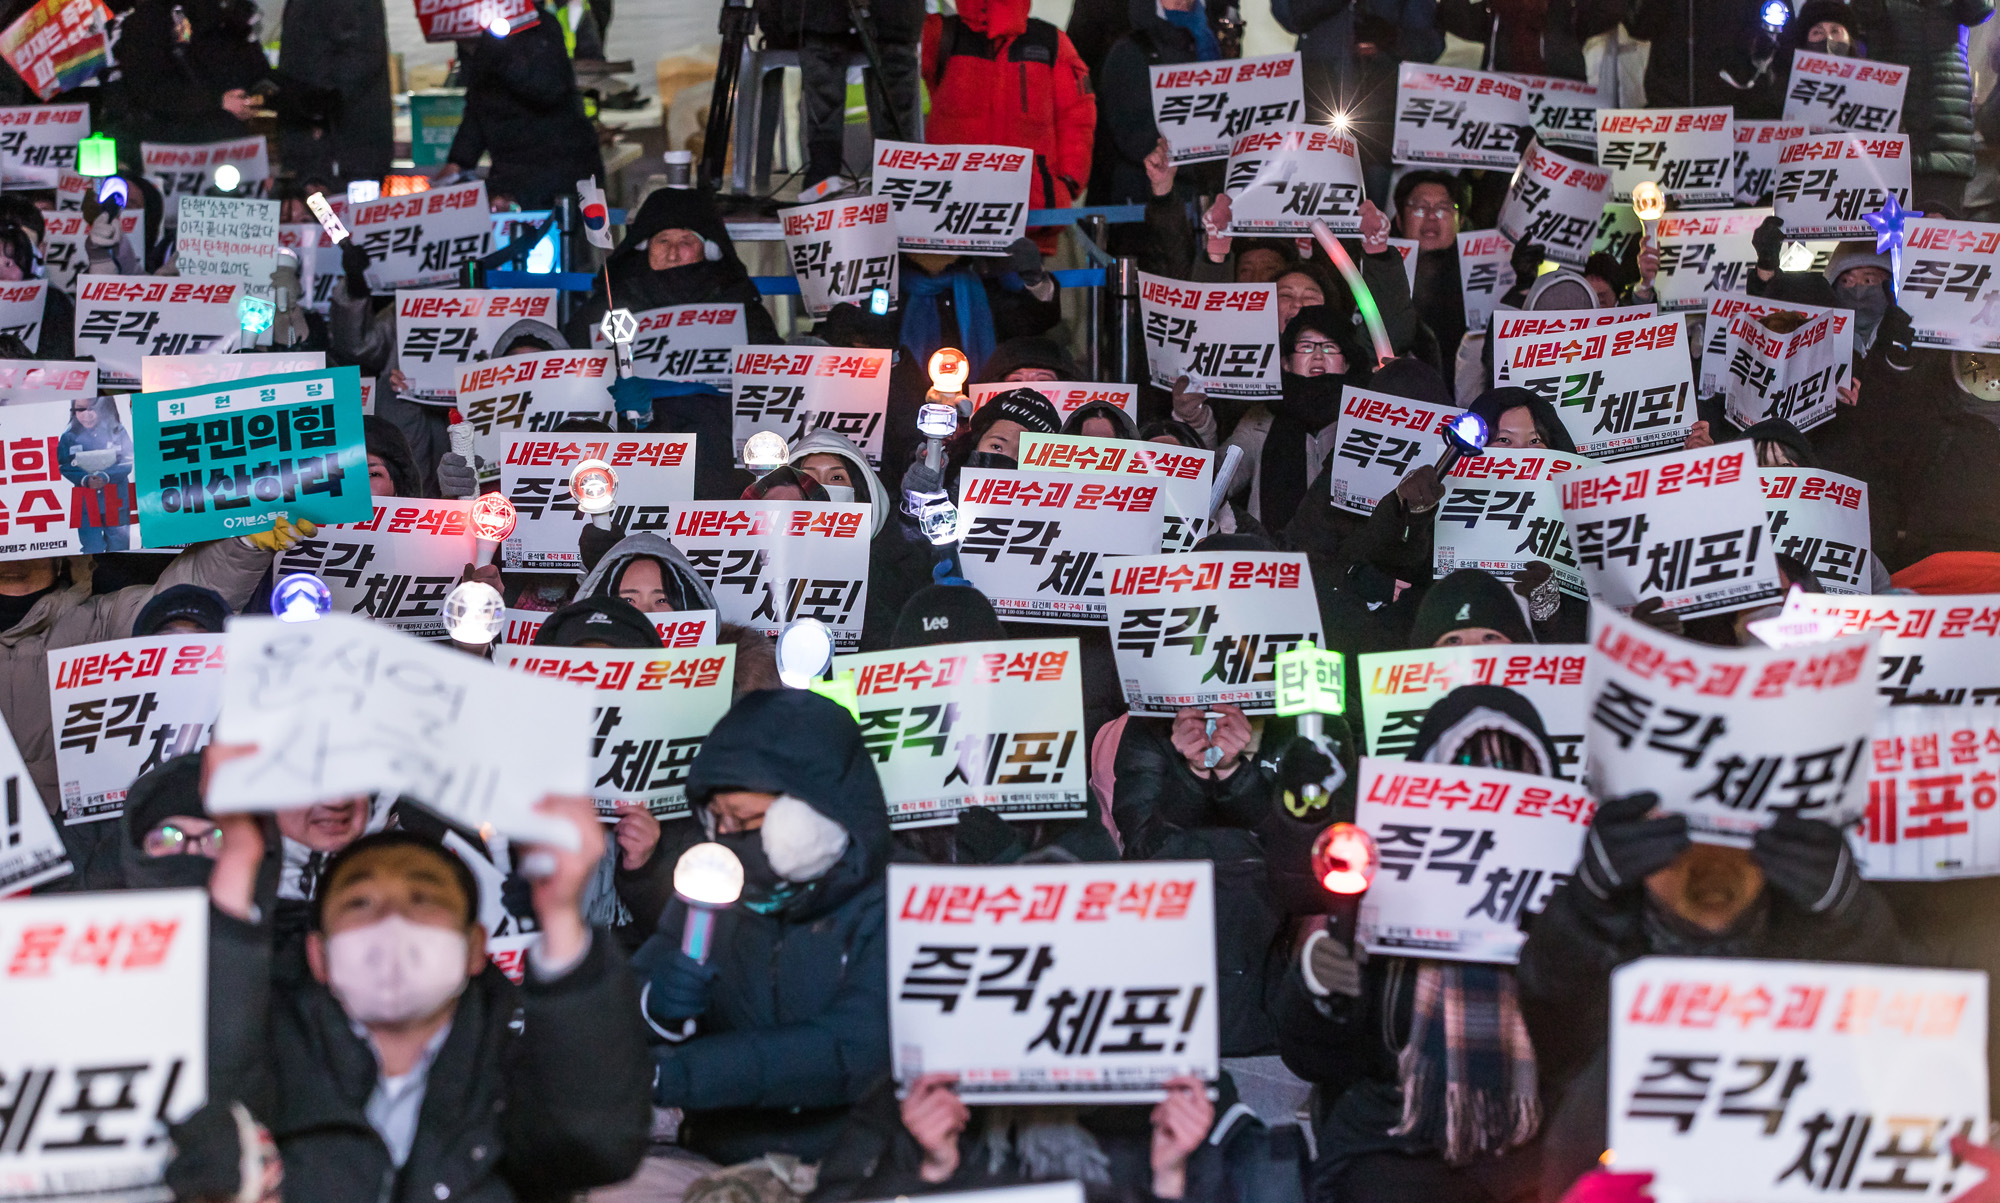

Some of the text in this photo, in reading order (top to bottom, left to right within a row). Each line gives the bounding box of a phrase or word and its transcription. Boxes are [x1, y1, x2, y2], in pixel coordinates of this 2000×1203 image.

[1156, 58, 1295, 90] 내란수괴 윤석열
[1474, 78, 1523, 102] 윤석열
[1795, 56, 1904, 88] 내란수괴 윤석열
[1158, 92, 1229, 126] 즉각
[1789, 78, 1845, 110] 즉각
[35, 109, 82, 124] 윤석열
[1401, 97, 1467, 129] 즉각
[1601, 113, 1727, 134] 내란수괴 윤석열
[1831, 98, 1899, 133] 체포!
[1307, 132, 1355, 159] 윤석열
[1757, 126, 1804, 144] 윤석열
[1779, 139, 1903, 165] 내란수괴 윤석열
[879, 149, 1025, 173] 내란수괴 윤석열
[1601, 141, 1668, 174] 즉각
[1659, 158, 1732, 191] 체포!
[878, 177, 952, 214] 즉각
[1560, 167, 1609, 193] 윤석열
[1775, 168, 1838, 202] 즉각
[355, 195, 425, 226] 내란수괴
[428, 188, 479, 213] 윤석열
[784, 202, 889, 237] 내란수괴 윤석열
[934, 202, 1024, 237] 체포!
[363, 226, 424, 262] 즉각
[1524, 206, 1595, 252] 체포!
[1906, 227, 2000, 254] 내란수괴
[792, 240, 831, 280] 즉각
[828, 254, 896, 298] 체포!
[1658, 243, 1716, 276] 즉각
[81, 283, 236, 304] 내란수괴 윤석열
[1142, 279, 1270, 313] 내란수괴 윤석열
[1902, 260, 1991, 301] 즉각
[401, 296, 550, 318] 내란수괴 윤석열
[677, 309, 738, 326] 윤석열
[79, 310, 159, 345] 즉각
[402, 327, 478, 363] 즉각
[1146, 311, 1198, 353] 즉각
[1513, 334, 1604, 368] 내란수괴
[1610, 322, 1679, 357] 윤석열
[1729, 317, 1781, 360] 내란수괴
[1784, 319, 1829, 360] 윤석열
[460, 356, 608, 394] 내란수괴 윤석열
[735, 353, 884, 379] 내란수괴 윤석열
[1188, 339, 1274, 379] 체포!
[1729, 347, 1777, 399] 즉각
[735, 385, 805, 423] 즉각
[1524, 370, 1604, 412] 즉각
[1592, 381, 1689, 436] 체포!
[1762, 364, 1831, 420] 체포!
[466, 391, 534, 436] 즉각
[1344, 396, 1436, 431] 내란수괴
[159, 404, 337, 464] 국민의힘
[1338, 428, 1421, 476] 즉각
[1661, 429, 1680, 439] 모이자!
[506, 442, 689, 467] 내란수괴 윤석열
[1022, 440, 1207, 480] 내란수괴 윤석열
[1447, 456, 1545, 481] 내란수괴
[160, 453, 345, 514] 해산하라
[963, 478, 1158, 512] 내란수괴 윤석열
[1562, 452, 1744, 511] 내란수괴 윤석열
[1798, 476, 1862, 510] 윤석열
[385, 506, 469, 536] 윤석열
[674, 510, 863, 538] 내란수괴 윤석열
[1439, 488, 1536, 529] 즉각
[30, 540, 68, 551] 시민연대
[960, 517, 1062, 567] 즉각
[1576, 511, 1650, 571] 즉각
[1640, 524, 1762, 594] 체포!
[279, 541, 376, 589] 즉각
[684, 549, 769, 595] 즉각
[1110, 560, 1300, 597] 내란수괴 윤석열
[1460, 560, 1508, 569] 윤석열 즉각 체포!
[751, 579, 863, 625] 체포!
[999, 599, 1012, 607] 즉각
[1014, 600, 1029, 608] 체포!
[1032, 600, 1051, 609] 김건희
[1053, 602, 1066, 610] 즉각
[423, 620, 444, 630] 모이자!
[922, 616, 949, 631] Lee
[1118, 605, 1220, 659] 즉각
[55, 647, 168, 690] 내란수괴
[636, 656, 726, 690] 윤석열
[849, 650, 1069, 696] 내란수괴 윤석열
[1501, 656, 1586, 686] 윤석열
[1594, 624, 1870, 699] 내란수괴 윤석열
[1220, 692, 1234, 701] 즉각
[1236, 690, 1253, 699] 구속!
[1282, 657, 1341, 708] 탄핵
[60, 691, 159, 754] 즉각
[858, 701, 962, 764] 즉각
[1594, 679, 1726, 770] 즉각
[943, 730, 1079, 788] 체포!
[1366, 774, 1510, 814] 내란수괴
[1373, 824, 1498, 885] 즉각
[900, 879, 1198, 923] 내란수괴 윤석열
[8, 921, 179, 977] 윤석열
[899, 943, 1055, 1014] 즉각
[1026, 985, 1205, 1056] 체포!
[1627, 982, 1827, 1032] 내란수괴
[1625, 1053, 1811, 1137] 즉각
